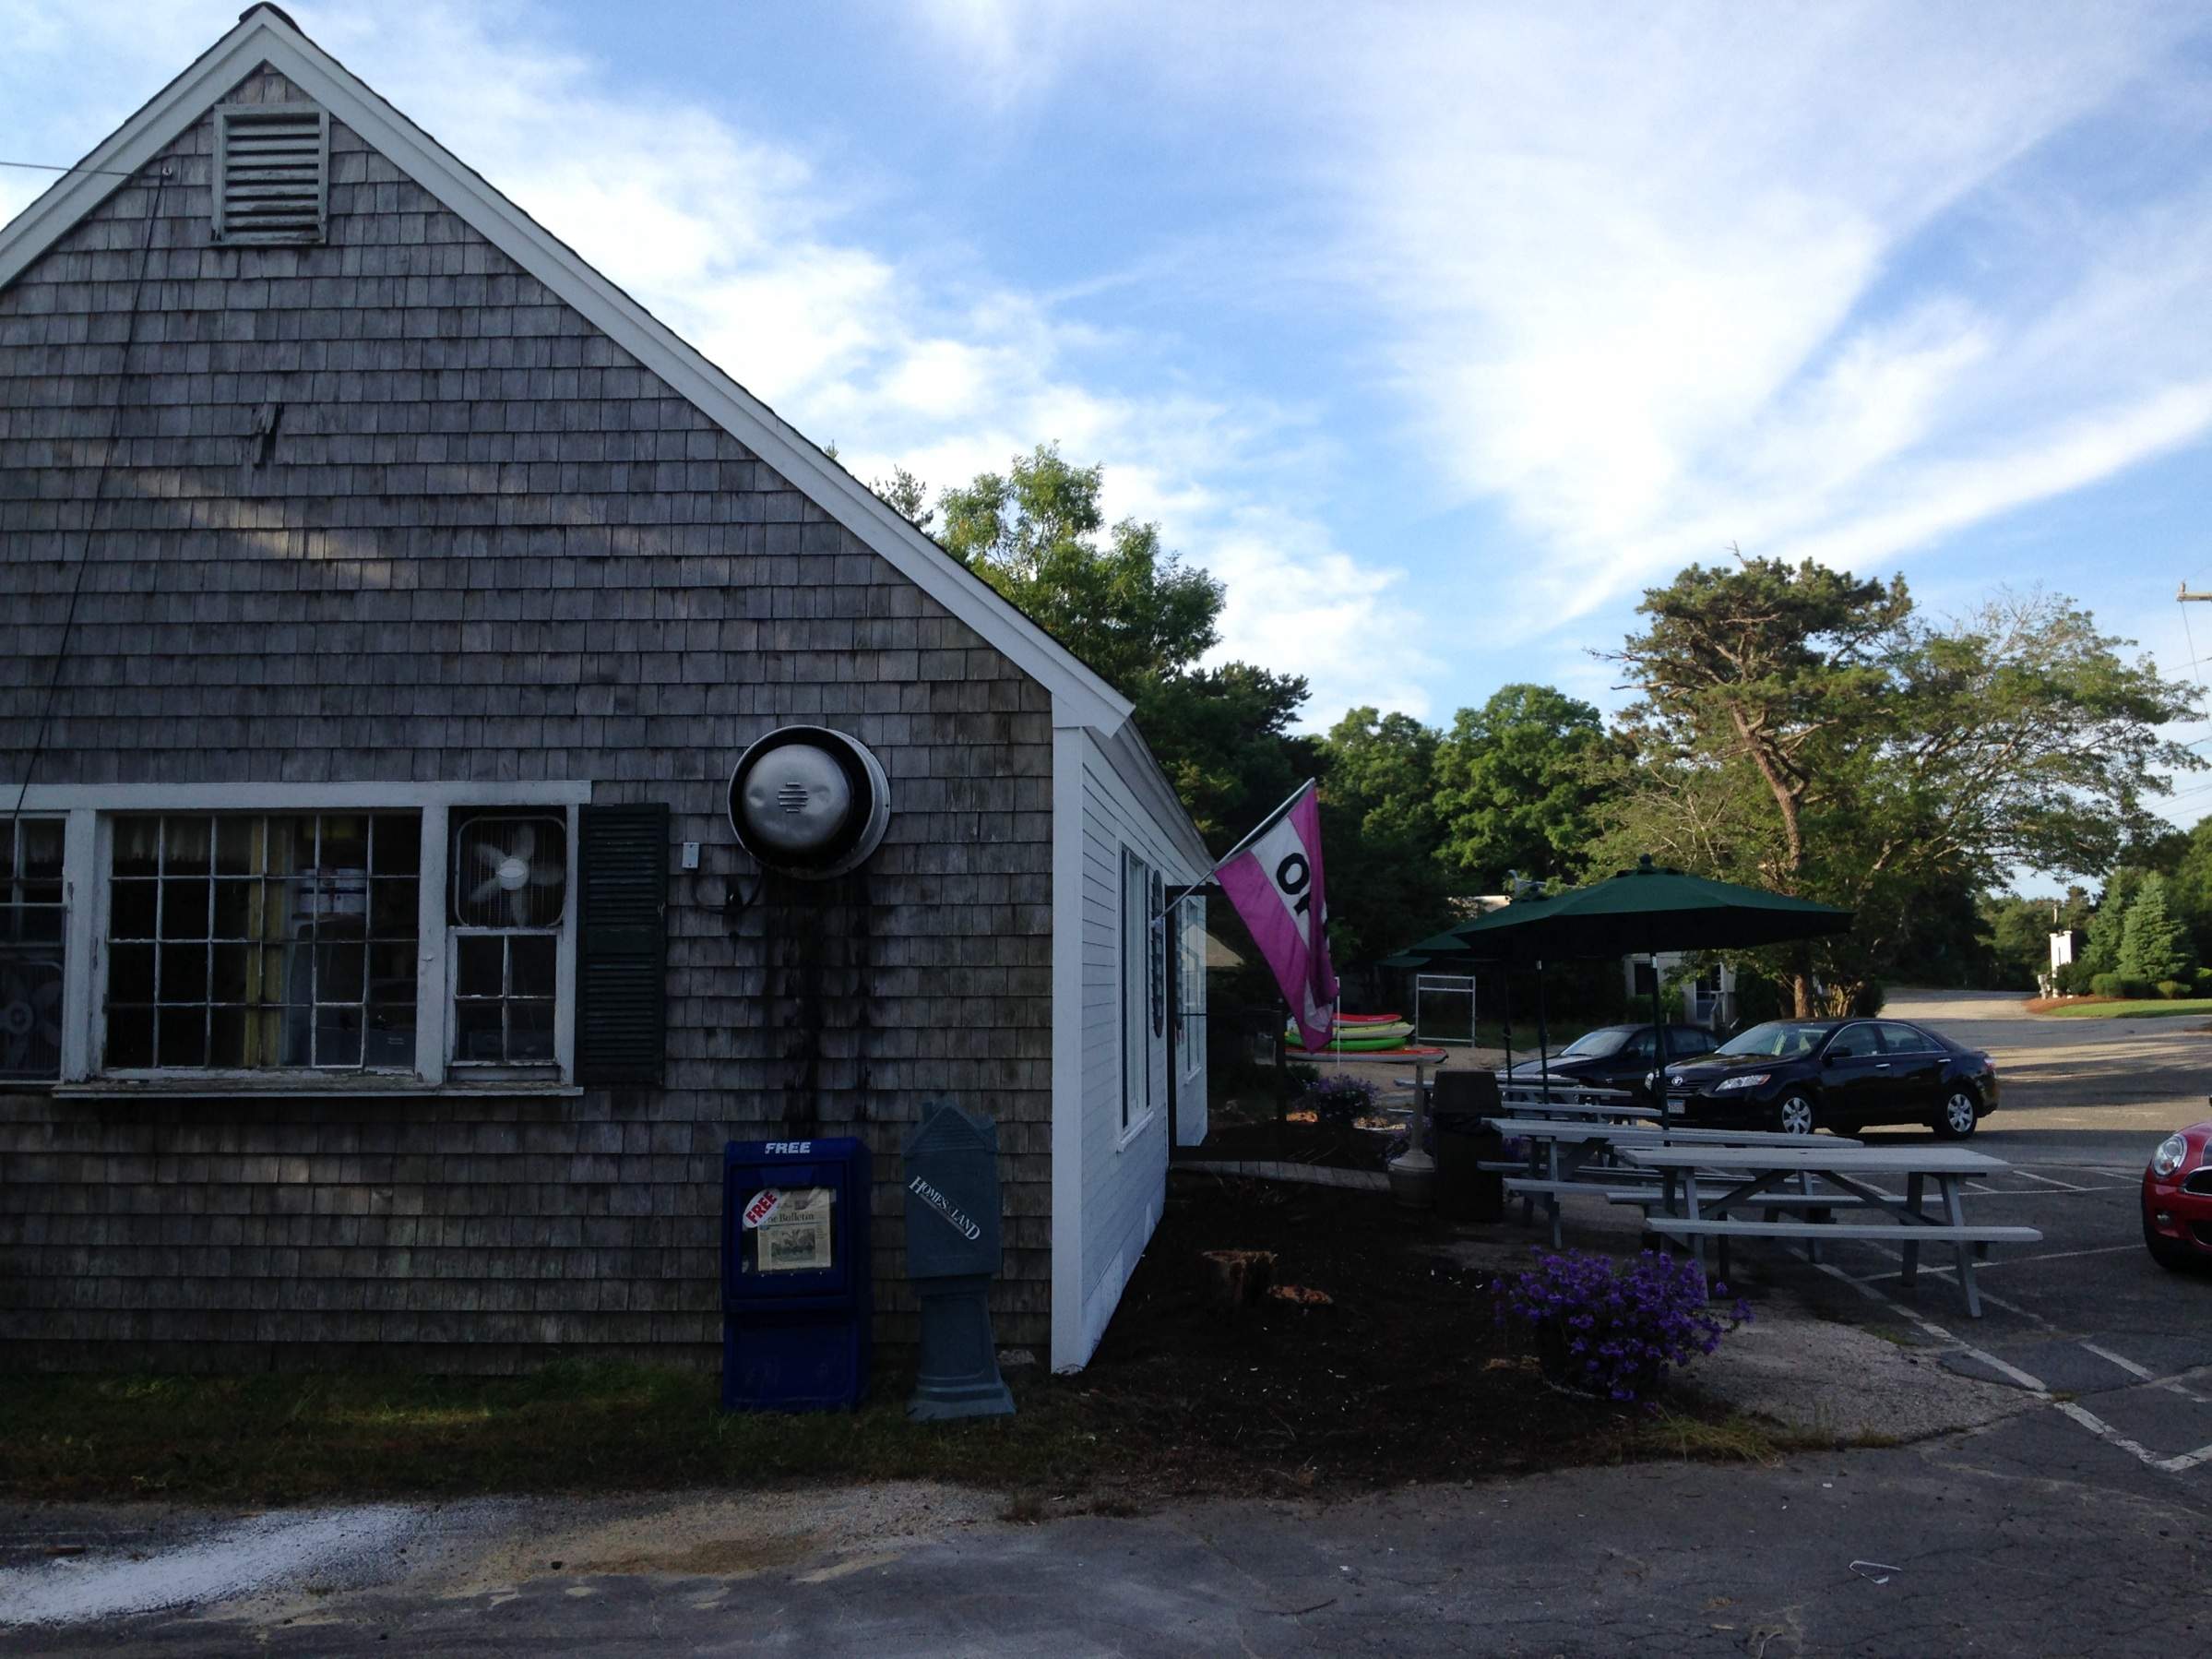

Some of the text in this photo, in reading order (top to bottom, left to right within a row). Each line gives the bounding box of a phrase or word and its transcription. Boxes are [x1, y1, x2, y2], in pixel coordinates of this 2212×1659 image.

[765, 1141, 812, 1153] FREE
[745, 1190, 778, 1224] FREE
[779, 1211, 815, 1223] Bulletin
[909, 1176, 981, 1240] HOMES LAND
